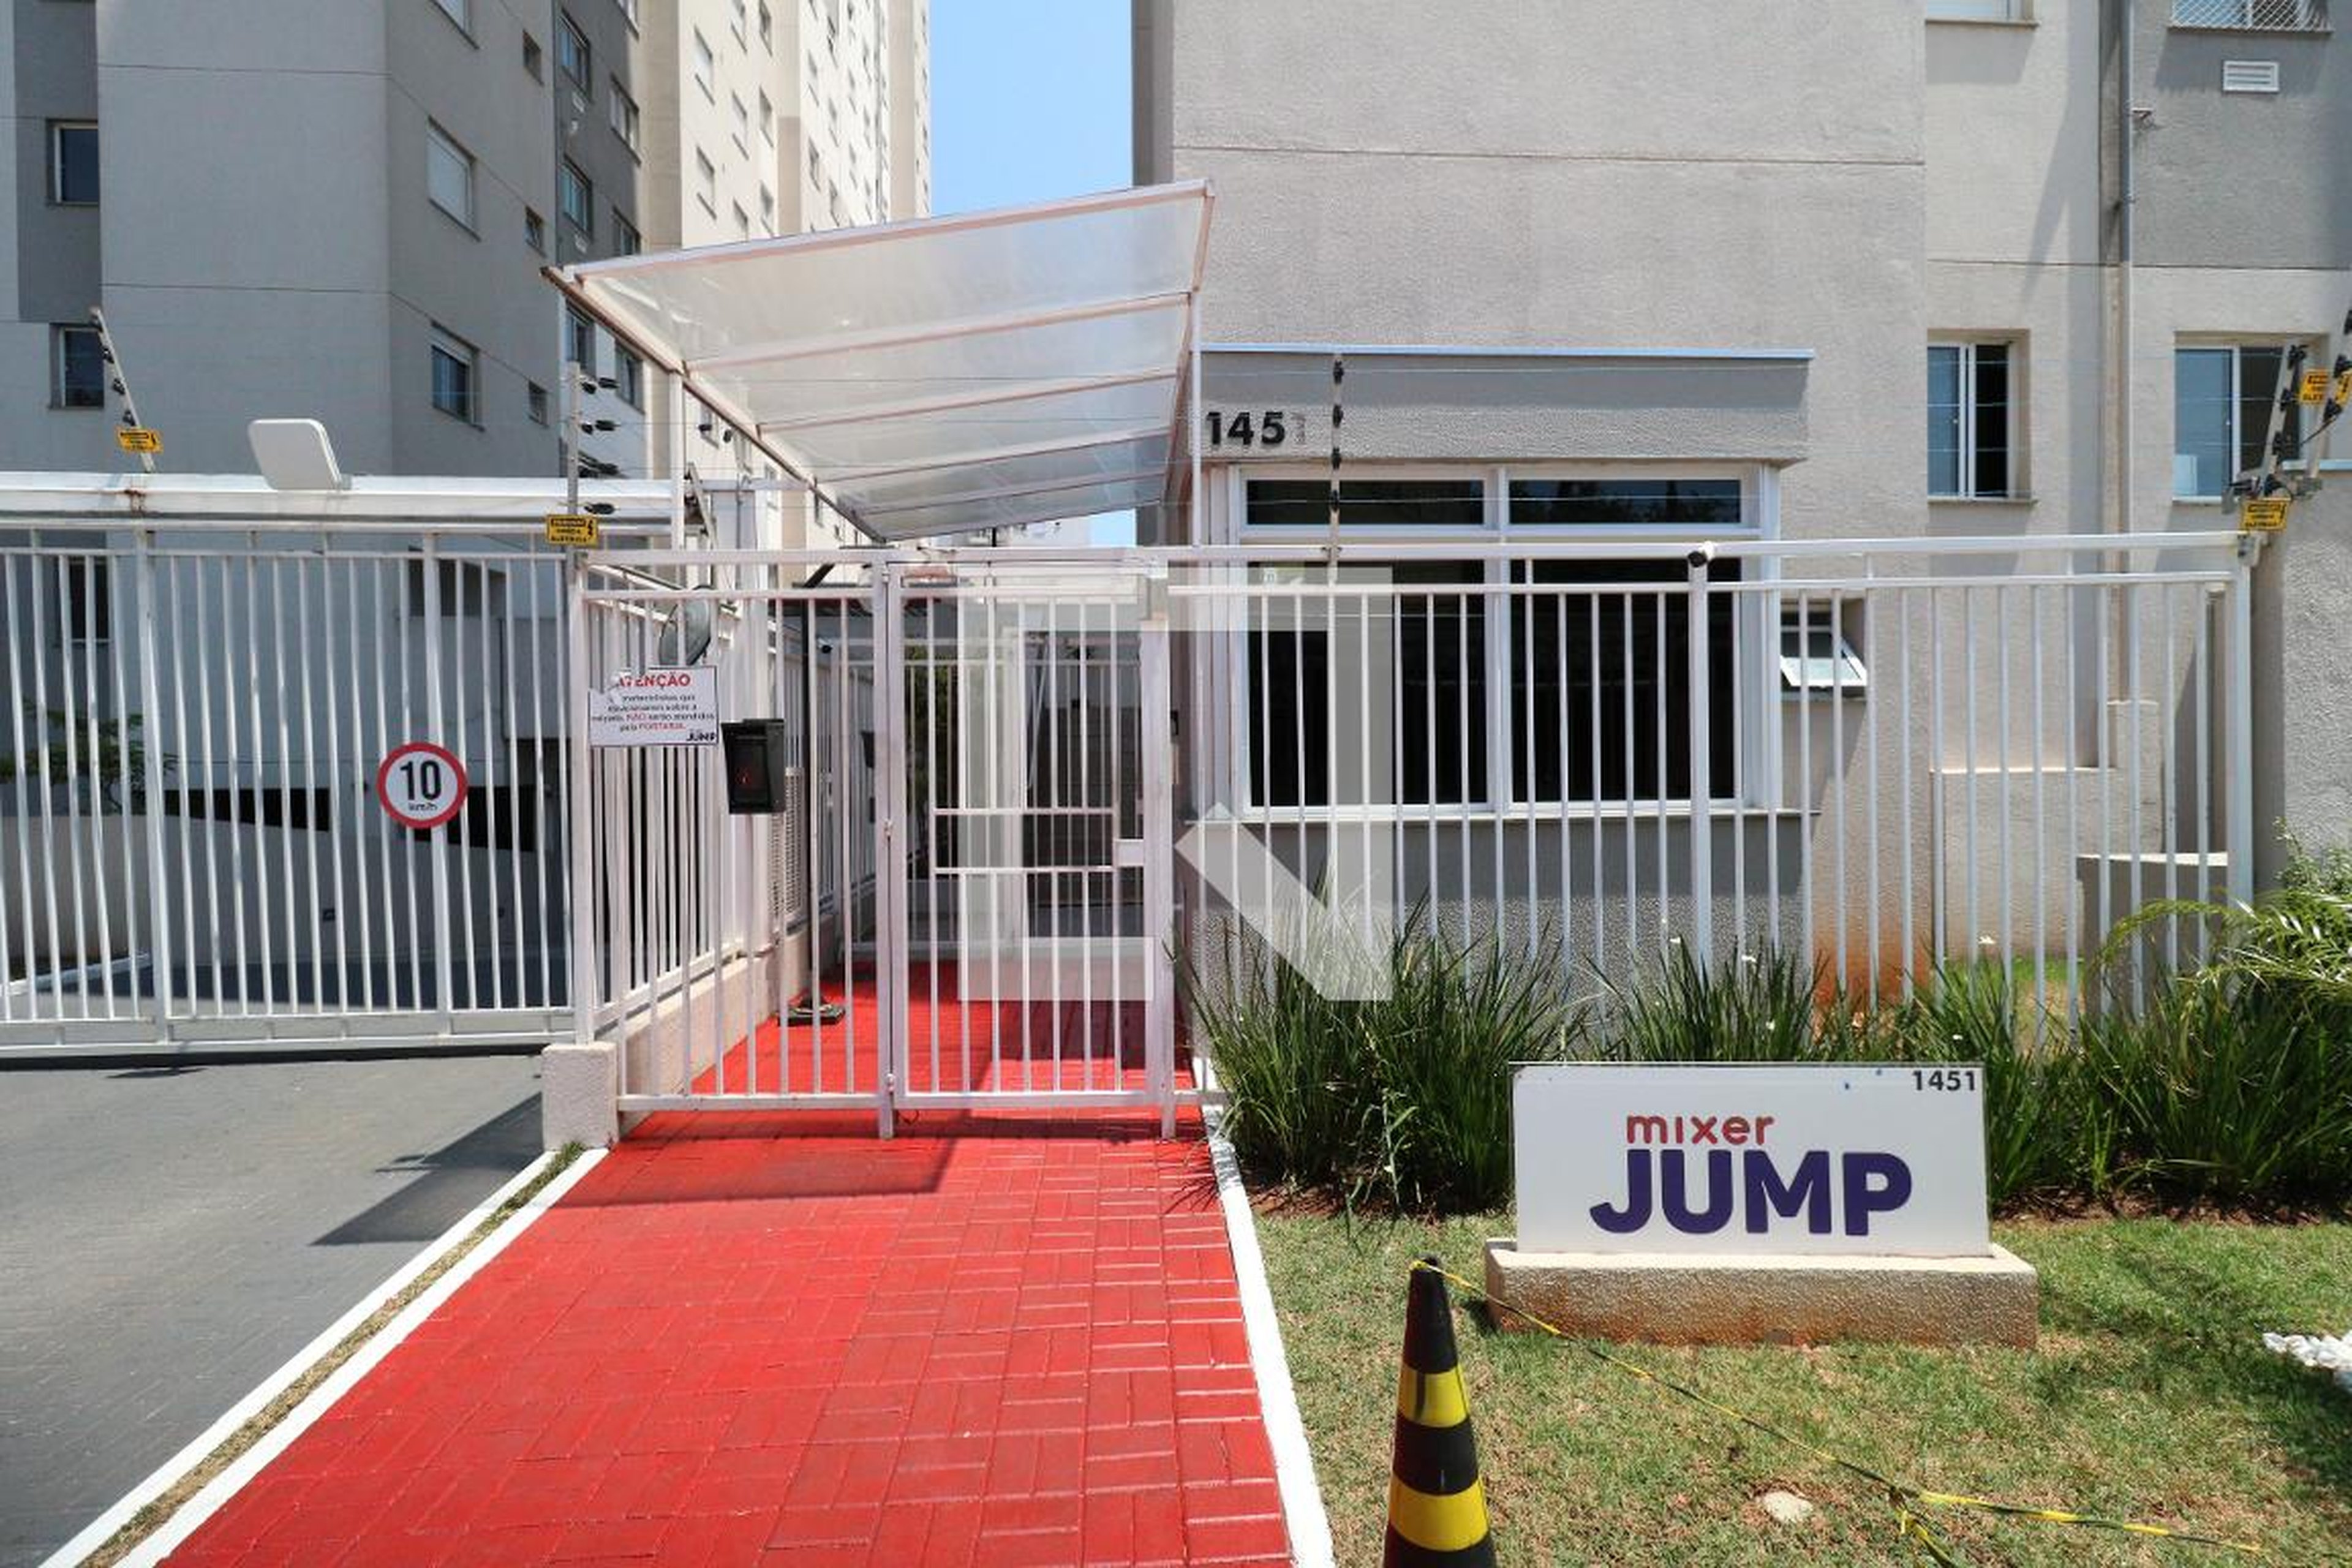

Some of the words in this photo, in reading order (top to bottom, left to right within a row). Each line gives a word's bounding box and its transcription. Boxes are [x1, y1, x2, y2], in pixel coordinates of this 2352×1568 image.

[686, 733, 716, 741] JUMP
[400, 760, 441, 801] 10
[1912, 1070, 1977, 1091] 1451
[1626, 1115, 1775, 1145] mixer
[1589, 1149, 1913, 1236] JUMP
